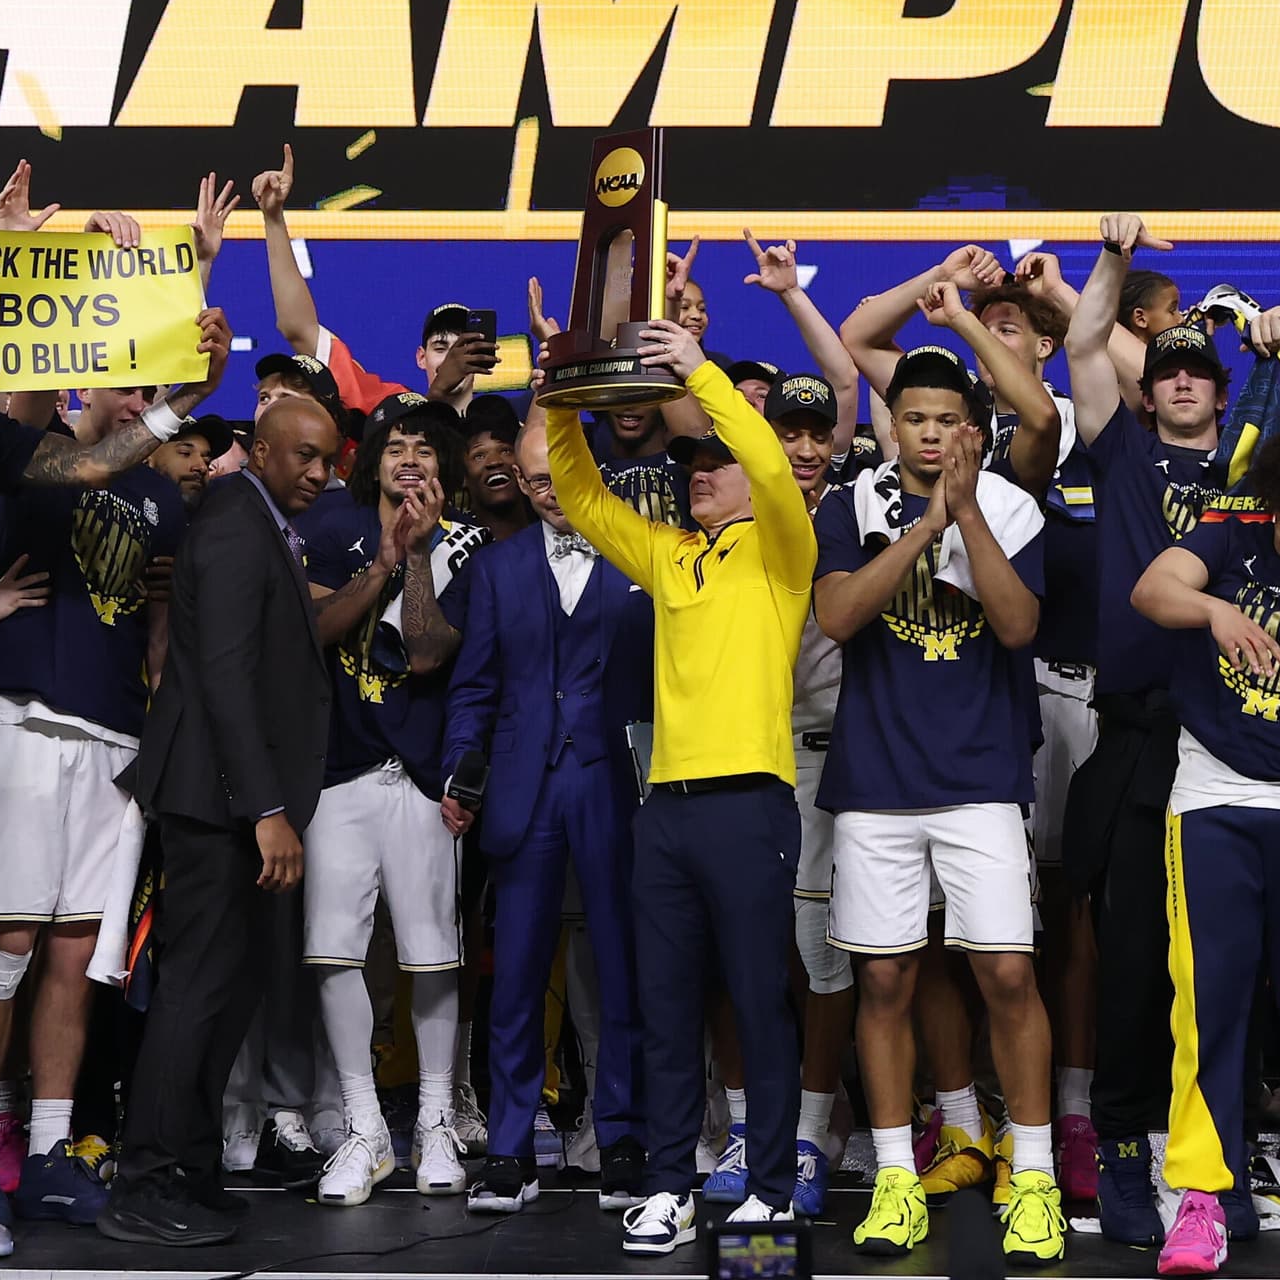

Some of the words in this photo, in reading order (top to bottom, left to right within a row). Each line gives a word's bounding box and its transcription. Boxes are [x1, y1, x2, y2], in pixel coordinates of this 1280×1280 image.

[596, 173, 640, 195] NCAA
[30, 247, 78, 280] THE
[88, 242, 194, 280] WORLD
[32, 341, 109, 375] BLUE
[556, 363, 588, 381] NATIONAL
[588, 360, 634, 376] CHAMPION
[782, 376, 830, 401] CHAMPIONS
[800, 391, 812, 400] M
[89, 593, 119, 626] M
[924, 634, 960, 662] M
[358, 677, 384, 705] M
[1169, 825, 1178, 919] MICHIGAN
[1117, 1141, 1139, 1159] M
